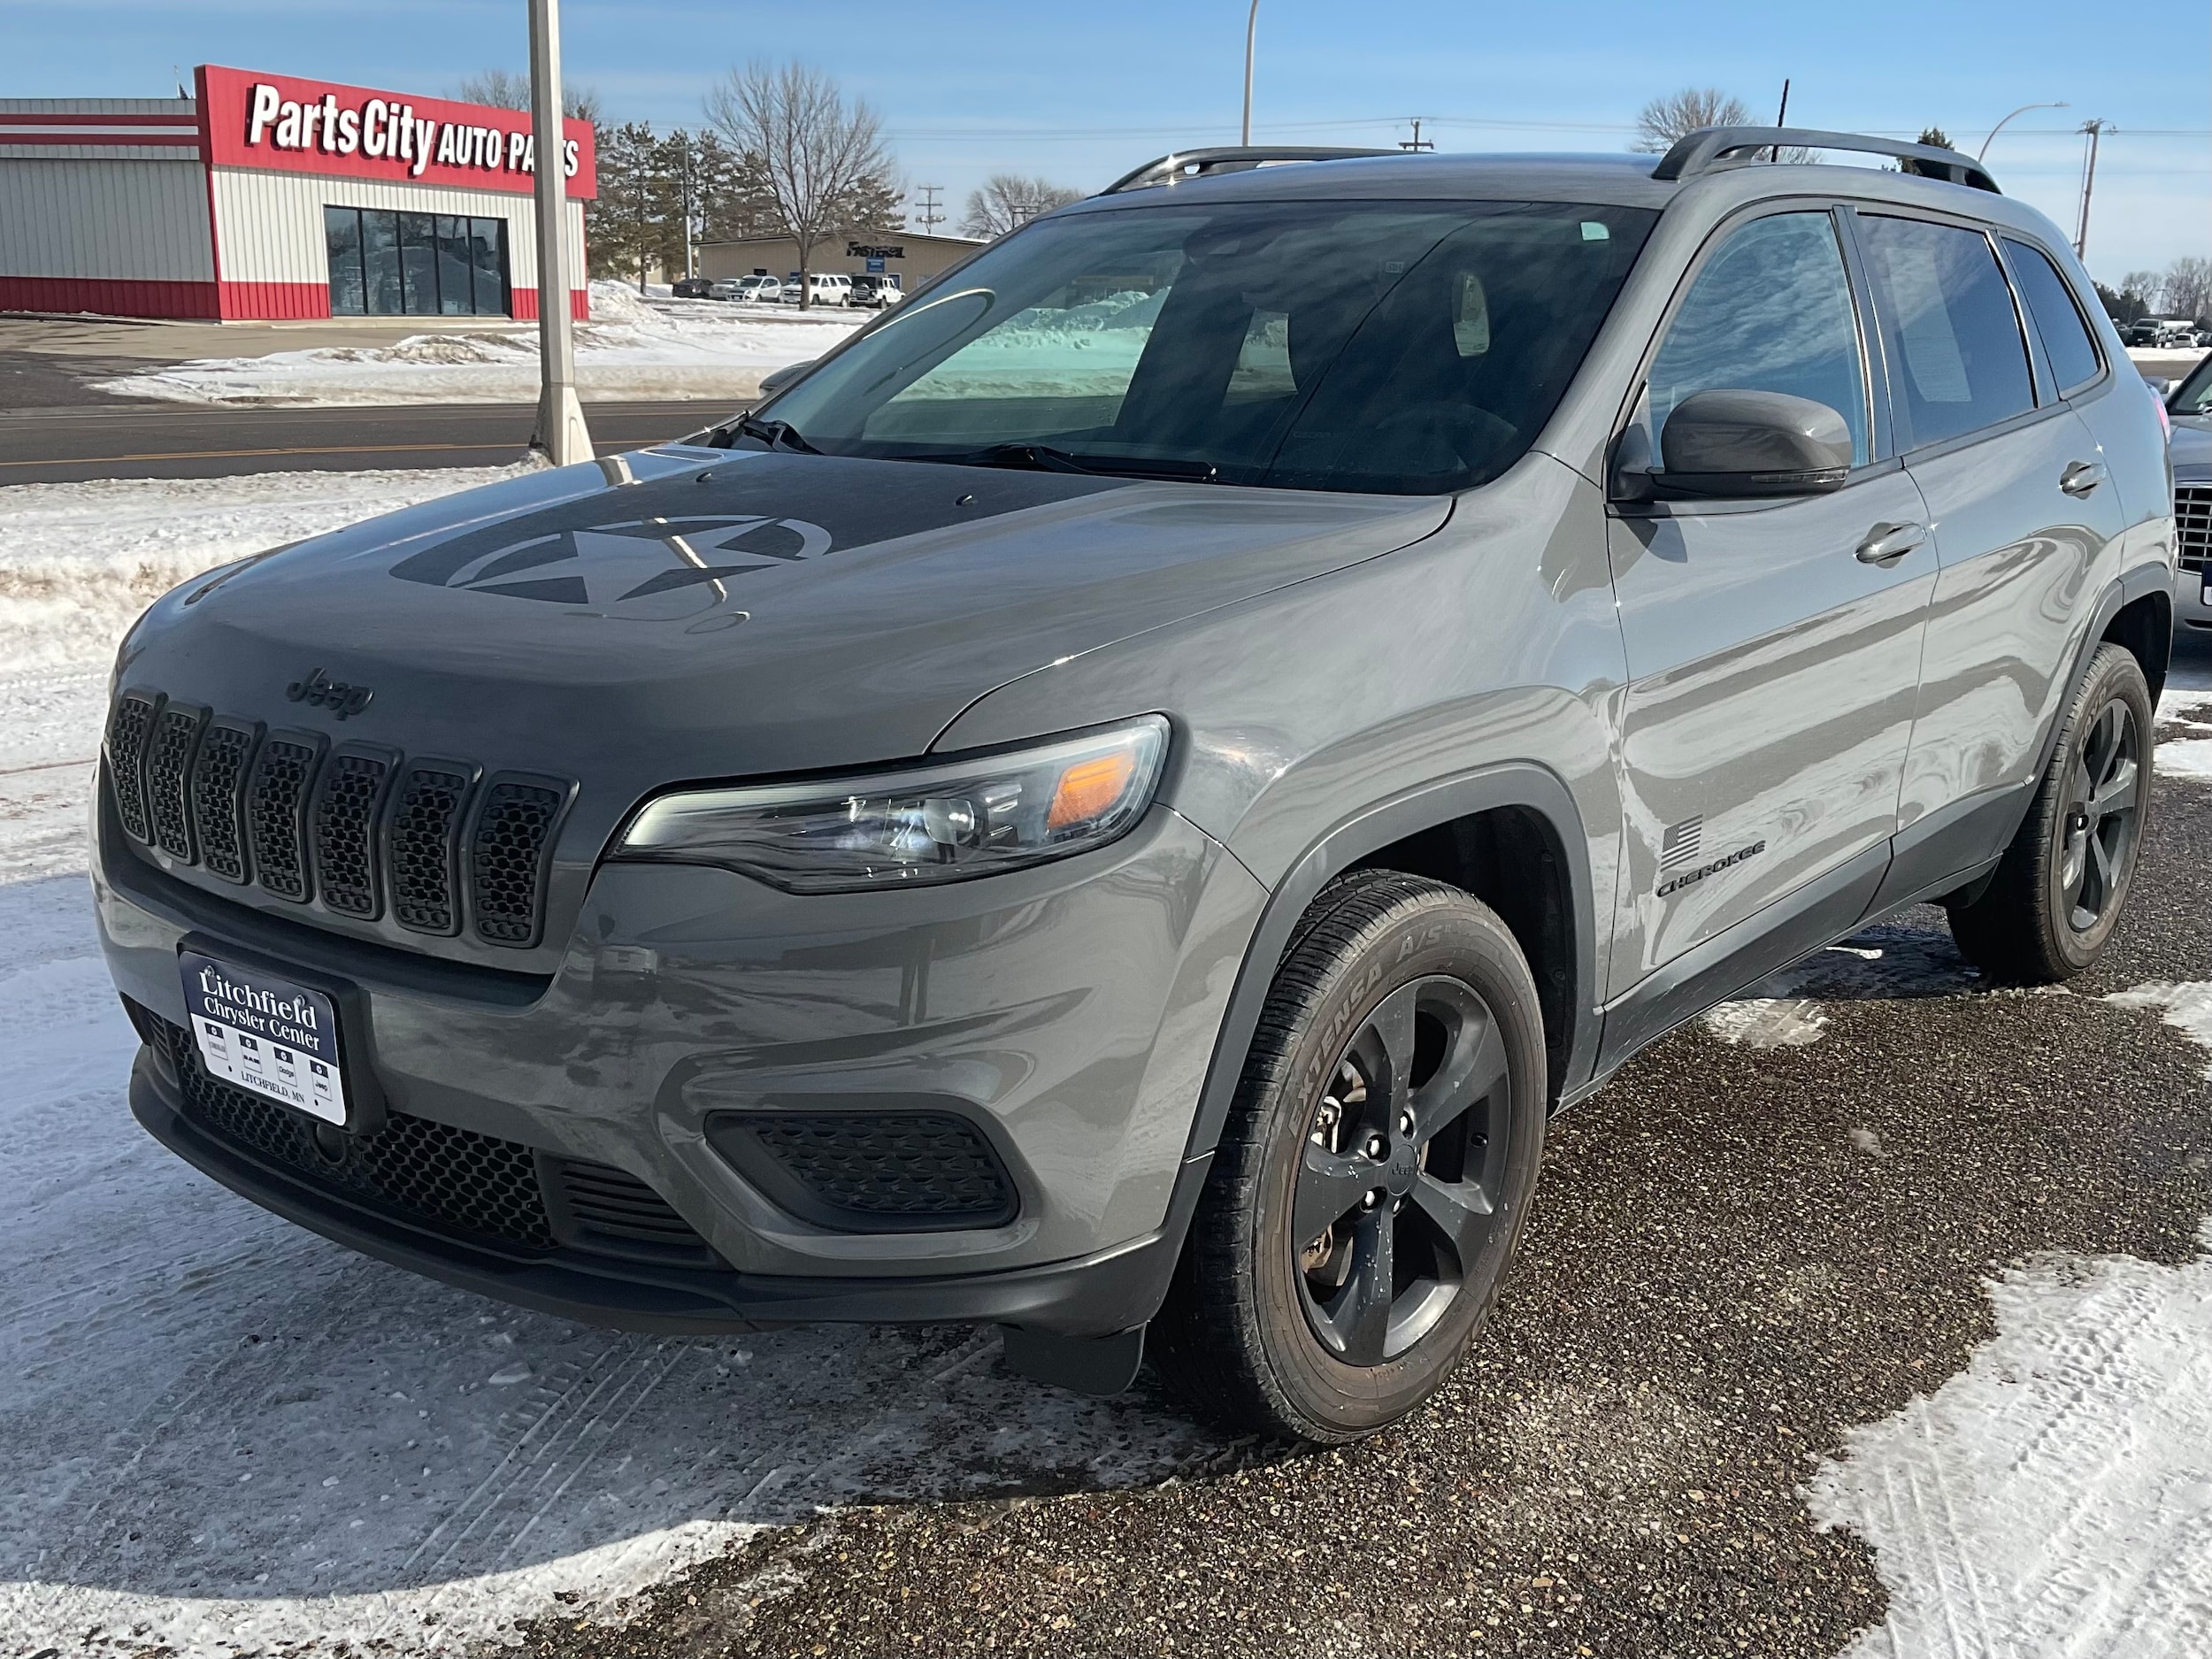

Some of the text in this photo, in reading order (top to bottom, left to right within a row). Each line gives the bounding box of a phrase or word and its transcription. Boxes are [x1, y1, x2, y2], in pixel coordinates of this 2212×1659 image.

[437, 122, 502, 169] AUTO
[509, 132, 579, 177] PAS
[1656, 840, 1766, 898] CHEROKEE
[199, 972, 318, 1031] Litchfield
[204, 996, 319, 1051] Chrysler Center
[1287, 962, 1382, 1139] EXTENSA
[241, 1071, 305, 1103] LITCHFIELD, MN
